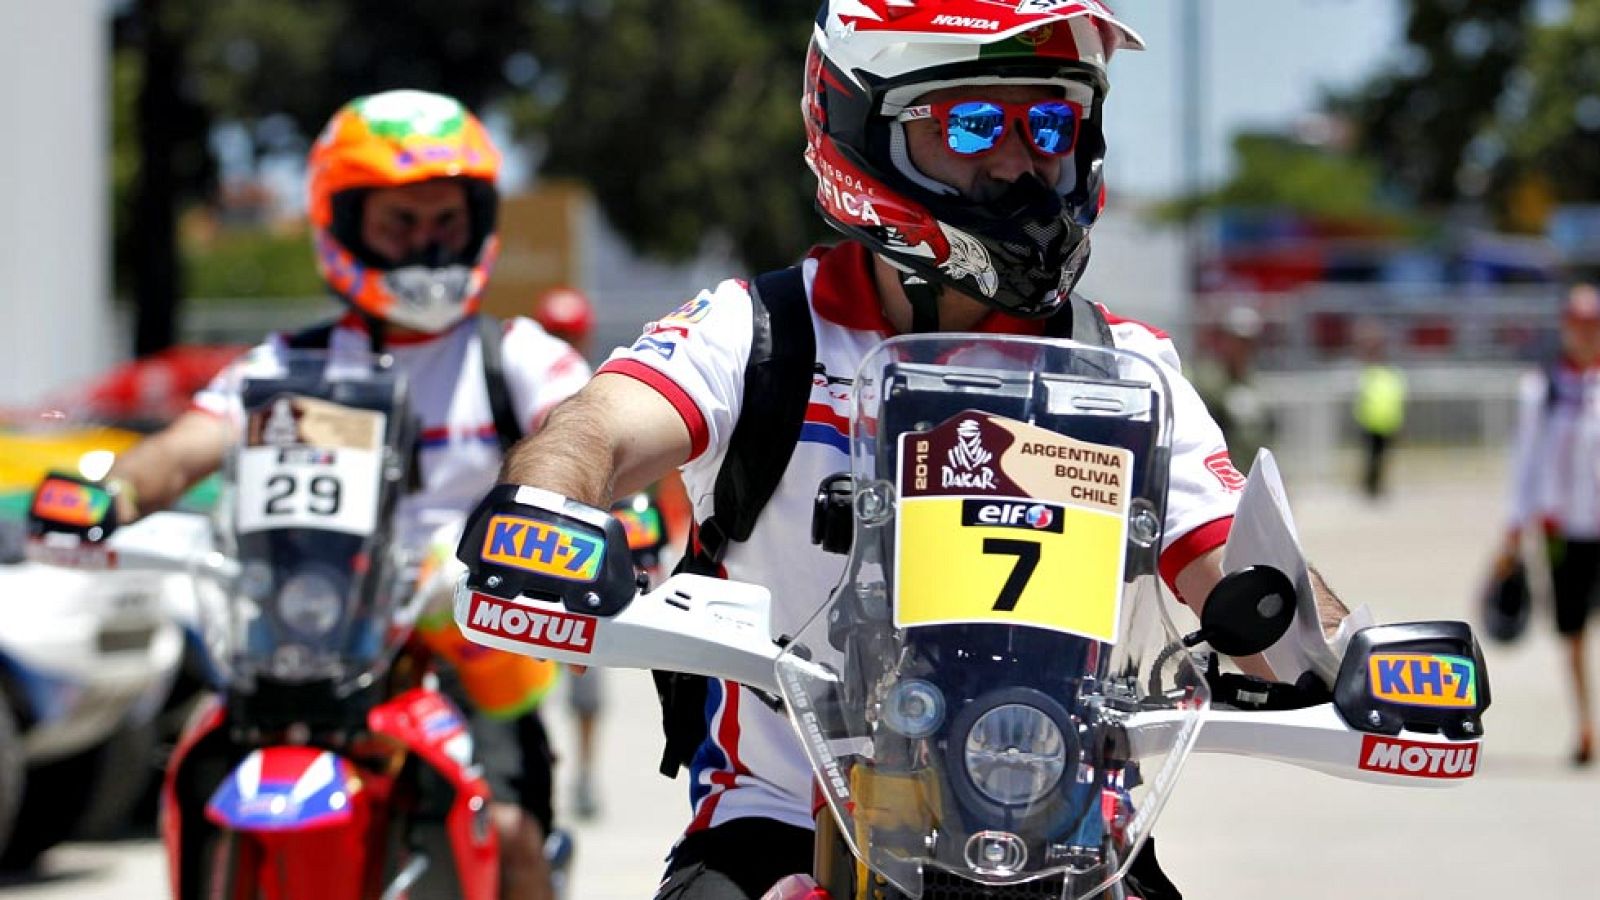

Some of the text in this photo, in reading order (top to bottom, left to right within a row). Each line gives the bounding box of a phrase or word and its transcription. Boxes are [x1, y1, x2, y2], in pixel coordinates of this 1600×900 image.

[931, 14, 1000, 30] HONDA
[818, 176, 881, 226] FICA
[915, 440, 929, 490] 2015
[1020, 442, 1122, 468] ARGENTINA
[264, 474, 342, 516] 29
[941, 465, 996, 490] DAKAR
[1055, 464, 1120, 487] BOLIVIA
[1070, 486, 1118, 506] CHILE
[490, 522, 596, 571] KH-7
[982, 537, 1042, 612] 7
[472, 601, 587, 645] MOTUL
[1377, 660, 1471, 699] KH-7
[1367, 742, 1474, 774] MOTUL
